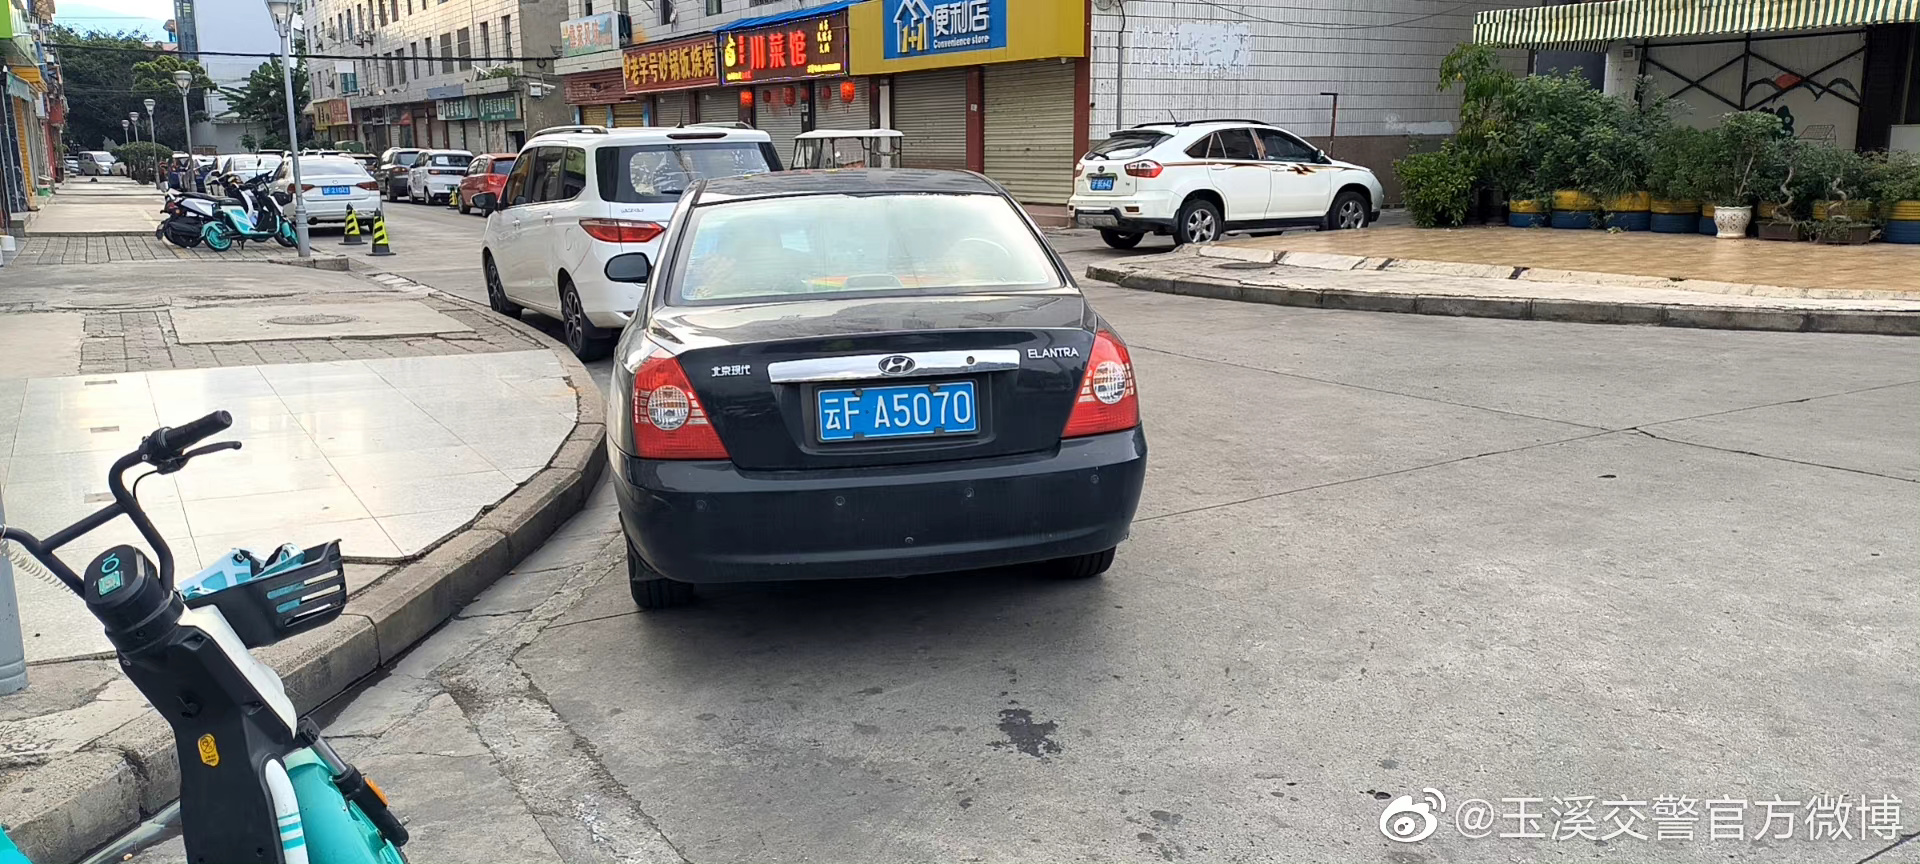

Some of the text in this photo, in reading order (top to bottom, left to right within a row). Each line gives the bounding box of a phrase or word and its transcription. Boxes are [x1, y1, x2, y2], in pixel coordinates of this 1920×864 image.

[932, 0, 990, 37] 便利店
[933, 35, 990, 49] Convenience store
[750, 30, 806, 70] 川菜馆
[1027, 347, 1080, 359] ELANTRA
[711, 364, 751, 377] 北京现代
